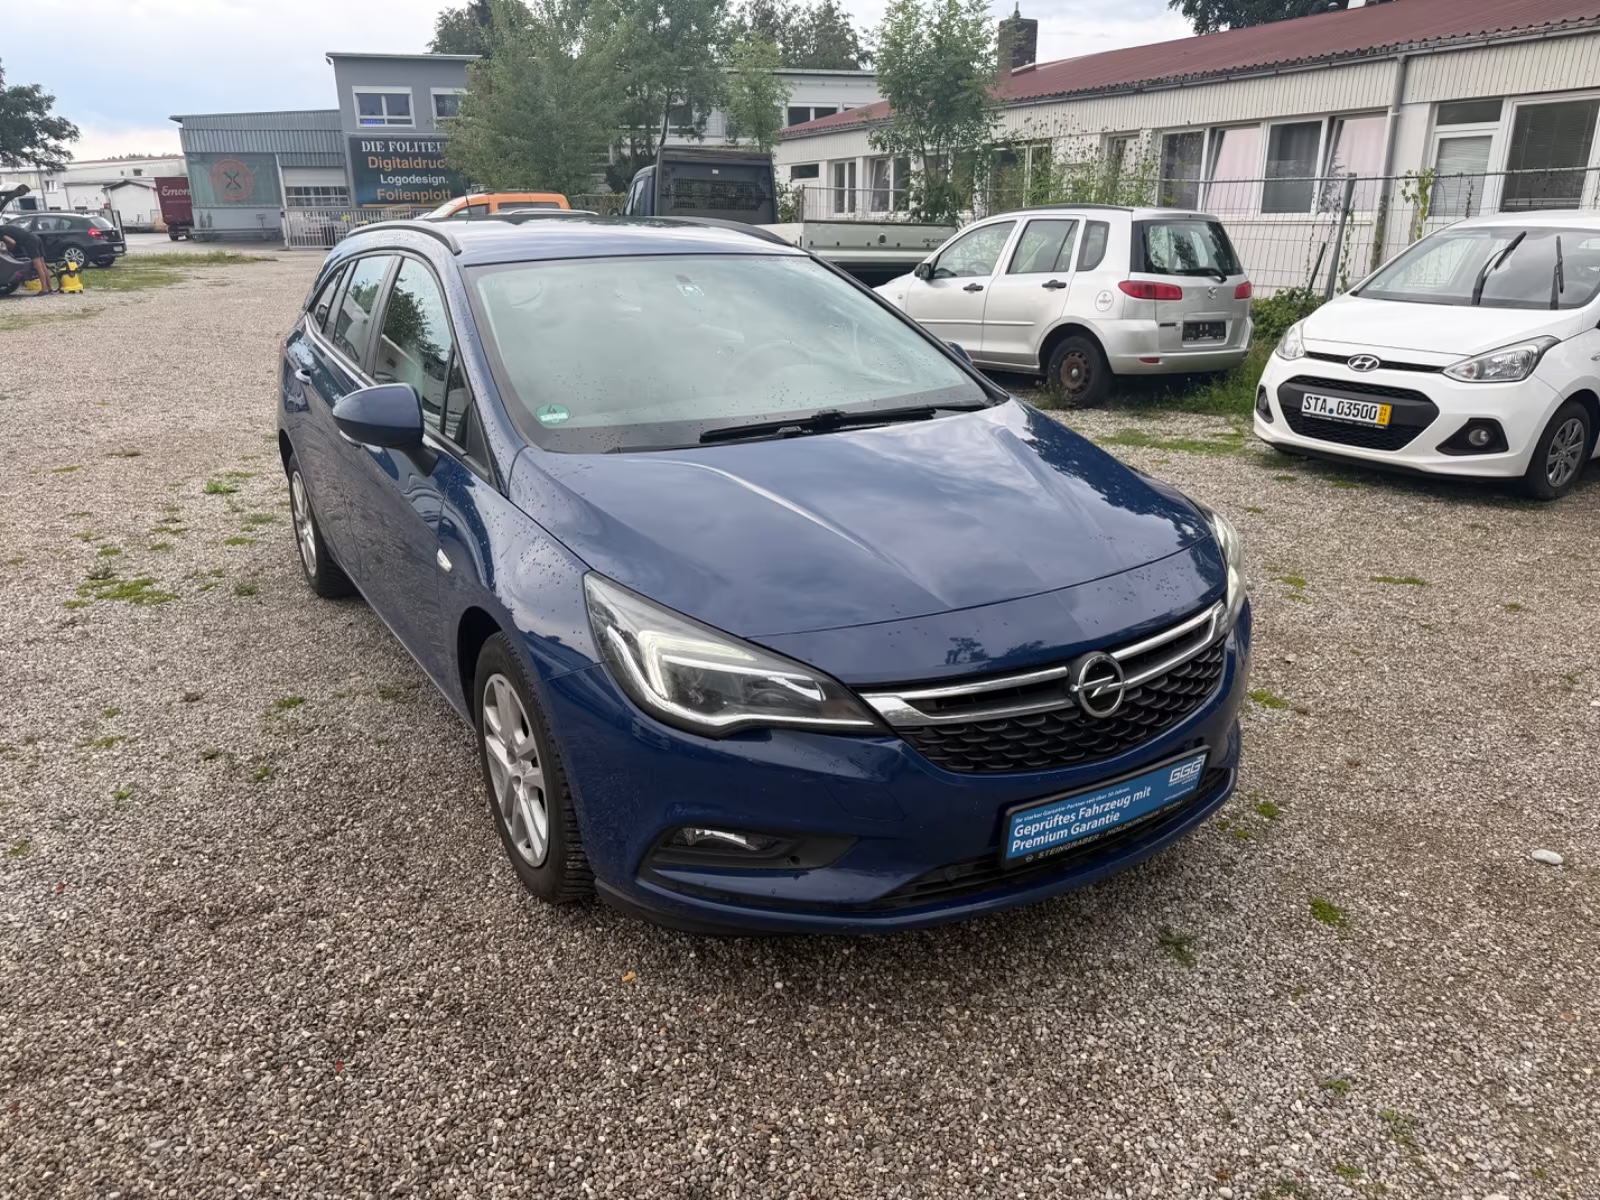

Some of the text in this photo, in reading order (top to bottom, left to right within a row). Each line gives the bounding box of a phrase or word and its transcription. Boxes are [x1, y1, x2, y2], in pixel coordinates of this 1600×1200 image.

[361, 141, 385, 152] DIE
[367, 156, 447, 172] Digitaldruc
[380, 174, 449, 186] Logodesign.
[161, 185, 191, 196] Emon
[376, 189, 452, 203] Folienplott
[1303, 395, 1328, 413] STA
[1336, 400, 1378, 421] 03500
[1169, 757, 1203, 783] GGG
[1013, 811, 1077, 838] Geprüftes
[1078, 794, 1132, 820] Fahrzeug
[1132, 785, 1152, 802] mit
[1011, 810, 1121, 853] Premium Garantie
